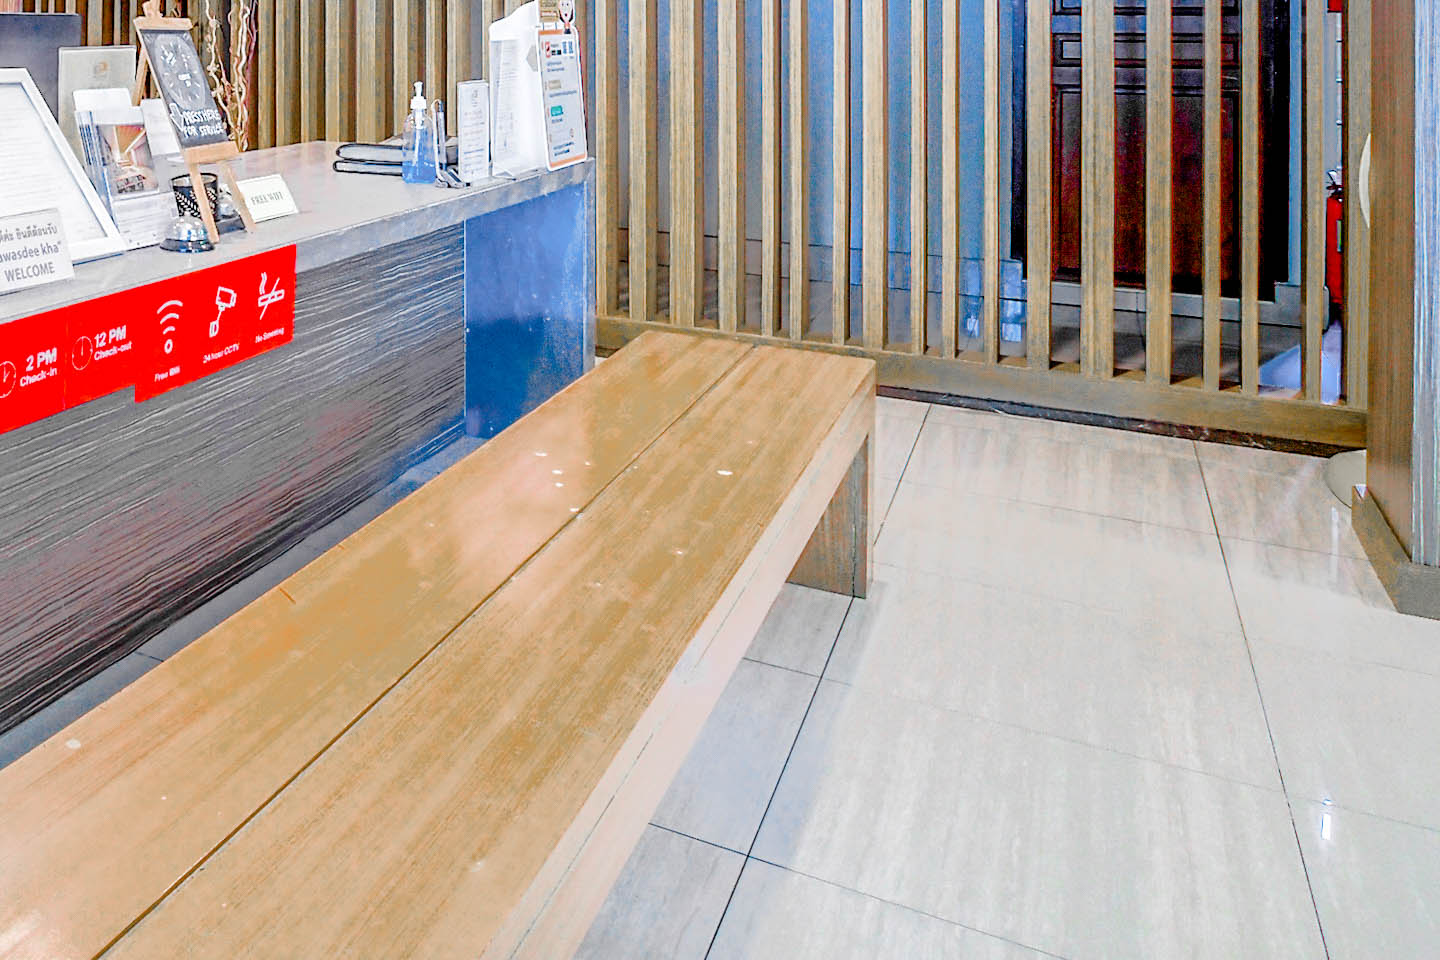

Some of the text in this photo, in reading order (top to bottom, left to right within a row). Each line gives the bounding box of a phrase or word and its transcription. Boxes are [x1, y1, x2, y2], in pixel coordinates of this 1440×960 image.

[4, 262, 56, 282] WELCOME
[94, 325, 127, 348] 12 PM
[25, 347, 58, 372] 2 PM
[94, 341, 132, 361] Check-out
[19, 367, 58, 387] Check-in
